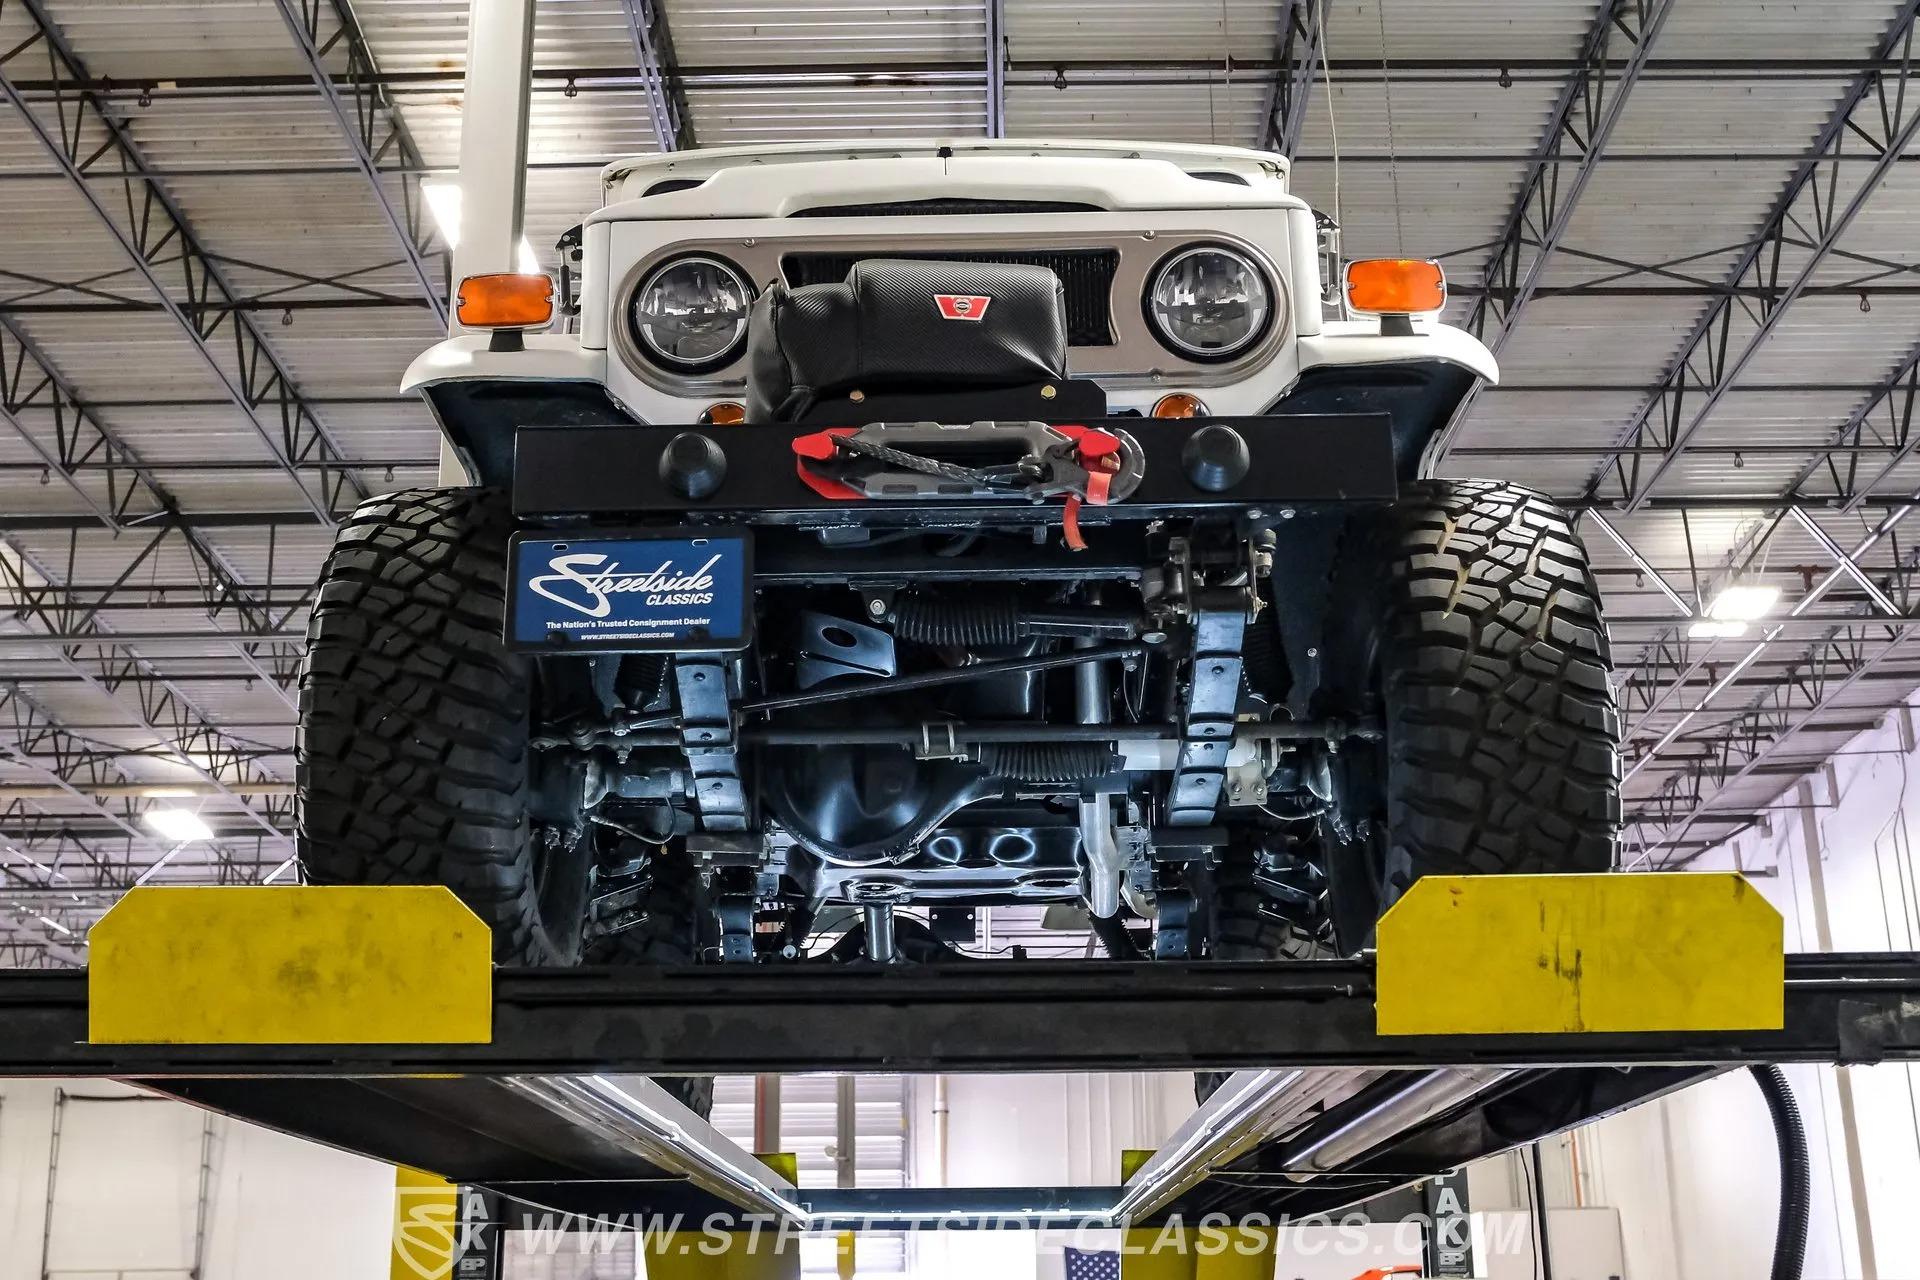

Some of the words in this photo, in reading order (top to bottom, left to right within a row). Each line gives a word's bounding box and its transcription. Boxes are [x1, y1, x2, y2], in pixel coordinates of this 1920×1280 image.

[529, 553, 722, 618] Streetside
[646, 592, 714, 606] CLASSICS
[546, 621, 562, 629] The
[562, 620, 596, 629] Nation's
[598, 619, 628, 628] Trusted
[629, 618, 683, 628] Consignment
[684, 617, 711, 626] Dealer
[580, 632, 675, 640] WWW.STREETSIDECLASSICS.COM
